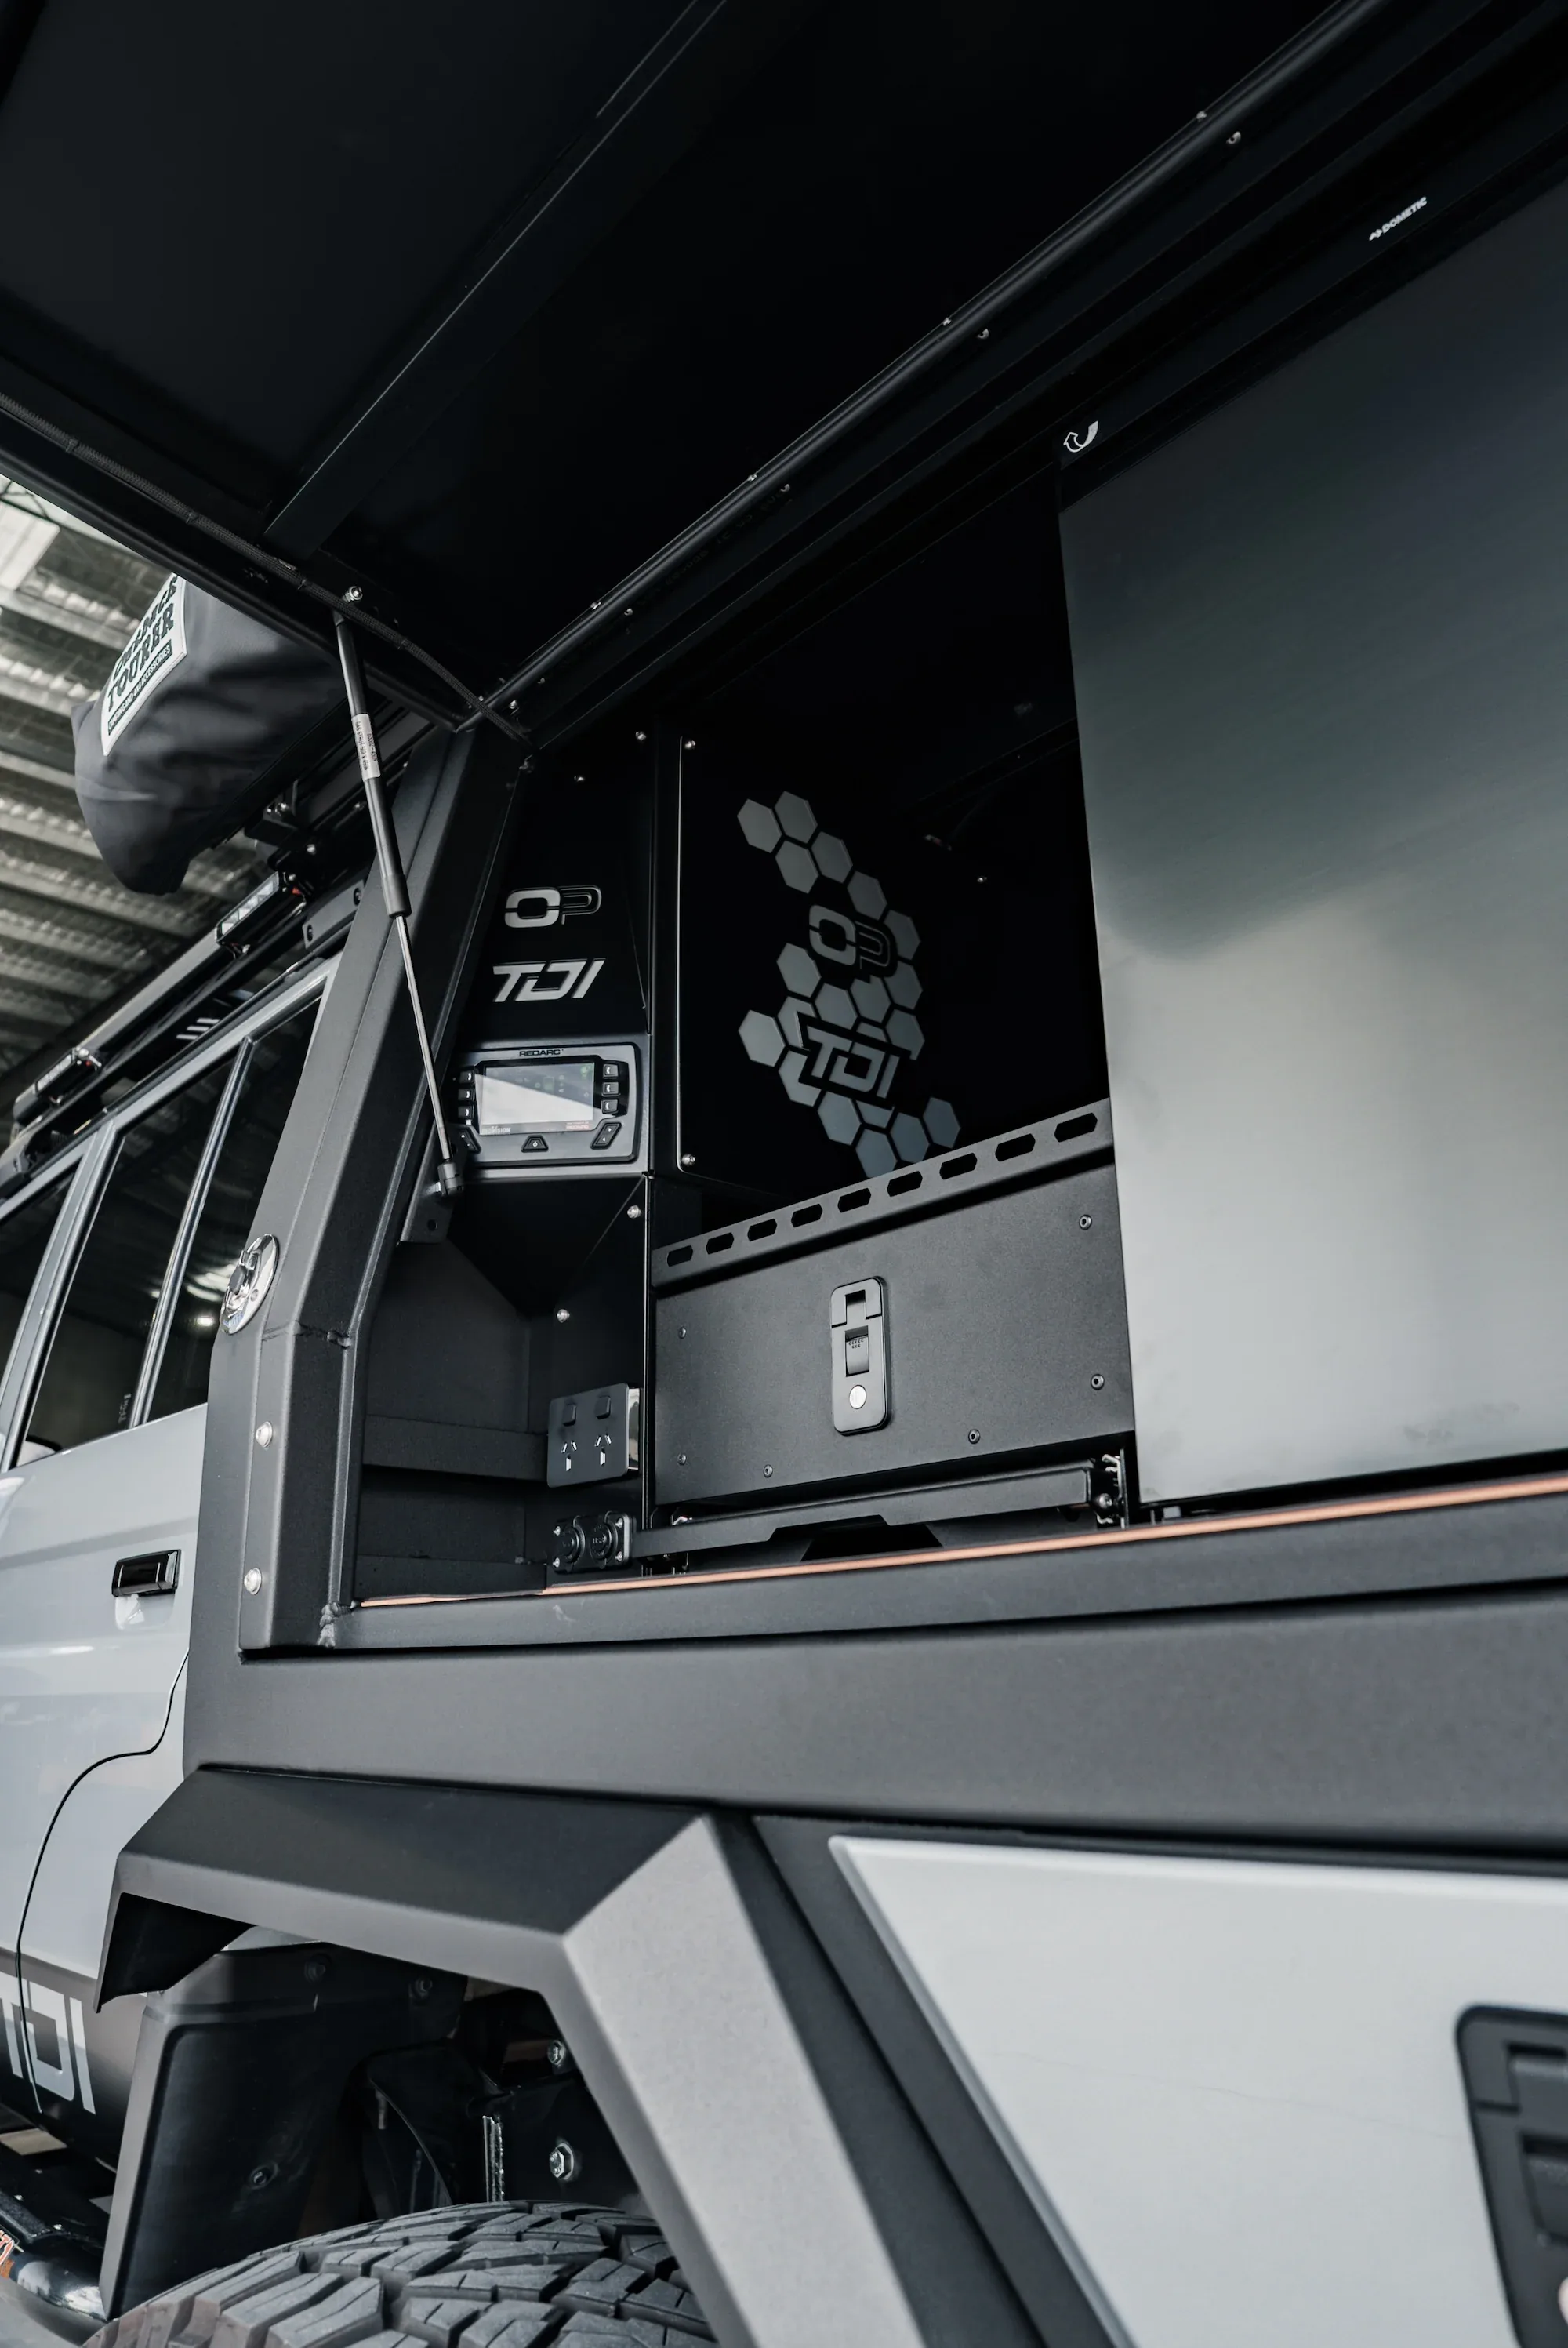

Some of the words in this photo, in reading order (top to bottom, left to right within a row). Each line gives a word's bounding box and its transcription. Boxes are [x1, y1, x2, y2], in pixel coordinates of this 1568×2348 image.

[1381, 196, 1428, 234] DOMETIC
[107, 602, 174, 713] TOURER
[141, 644, 171, 687] ACCESSORIES
[492, 958, 607, 1003] TDI
[519, 1049, 561, 1057] REDARC
[807, 1025, 901, 1099] TDI
